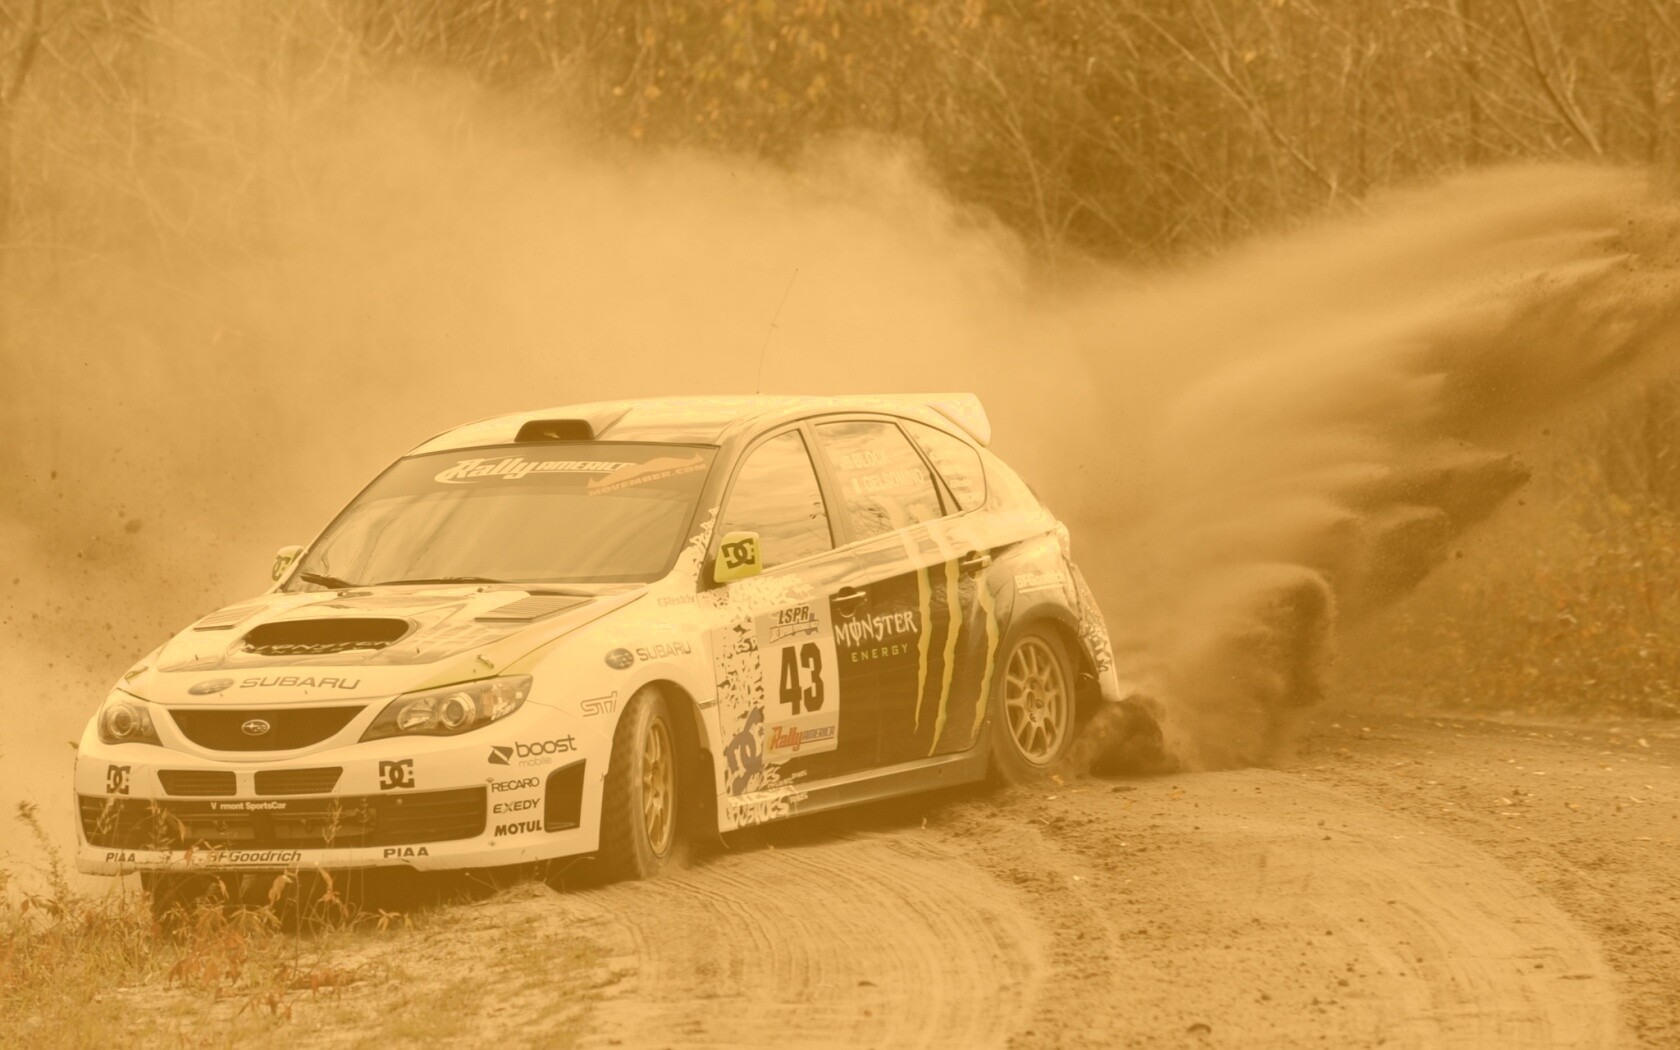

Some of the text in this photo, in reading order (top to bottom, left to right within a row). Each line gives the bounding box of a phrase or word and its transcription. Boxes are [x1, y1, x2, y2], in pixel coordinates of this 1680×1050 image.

[442, 455, 537, 481] Rally
[778, 605, 810, 625] LSPR
[635, 641, 692, 662] SUBARU
[851, 643, 909, 663] ENERGY
[239, 677, 361, 690] SUBARU
[779, 641, 825, 716] 43
[514, 734, 578, 760] boost
[490, 776, 541, 793] RECARO
[210, 801, 287, 811] Vrmont SportsCar
[492, 798, 542, 814] EXEDY
[493, 820, 543, 837] MOTUL
[105, 853, 136, 863] PIAA
[382, 846, 430, 859] PIAA
